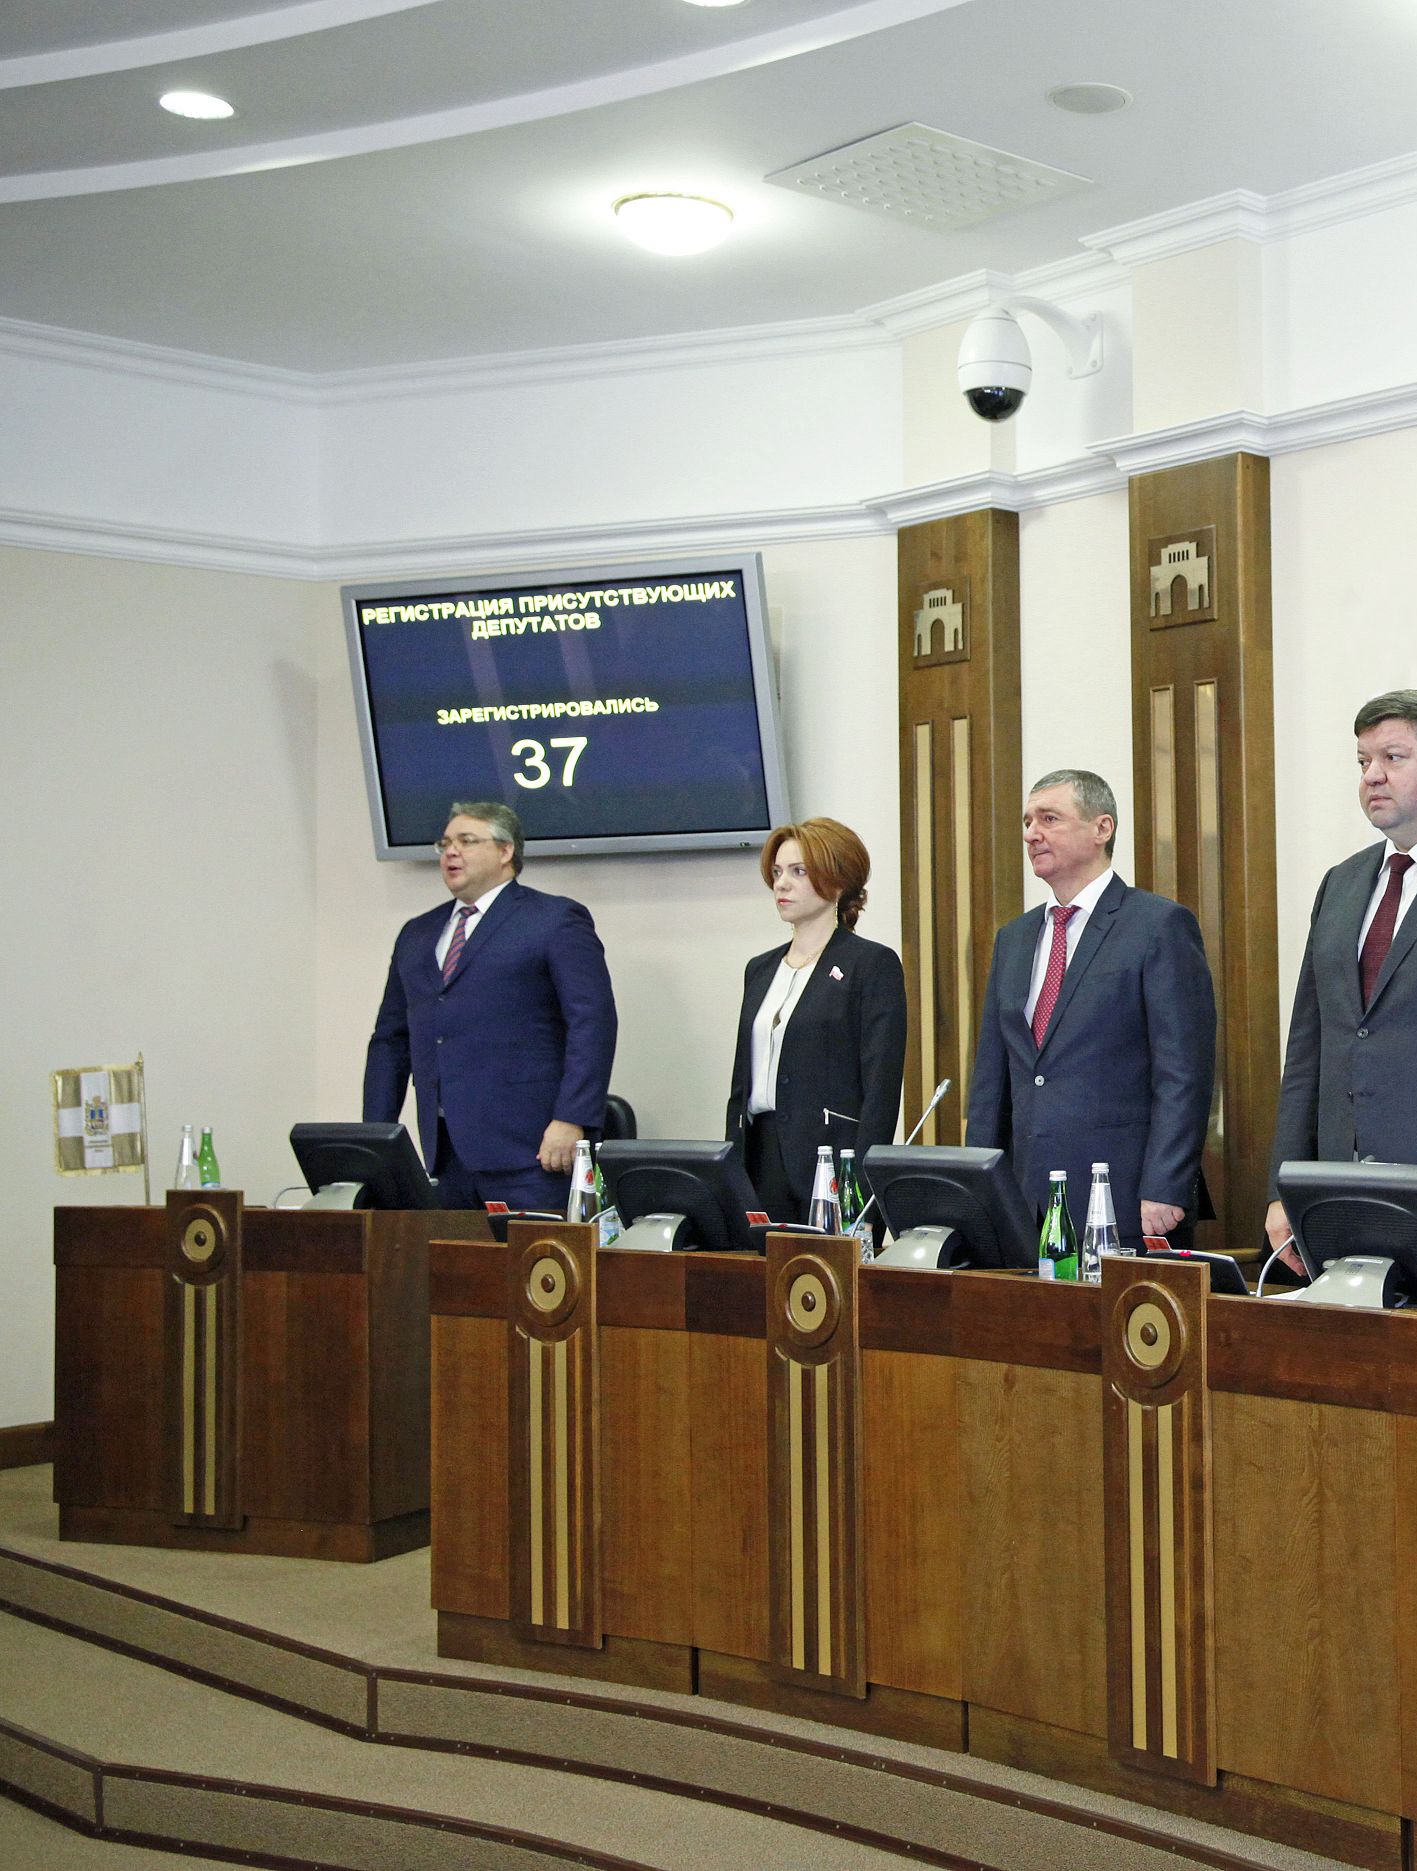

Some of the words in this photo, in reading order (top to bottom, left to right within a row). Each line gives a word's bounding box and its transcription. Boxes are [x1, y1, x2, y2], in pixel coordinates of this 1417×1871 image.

[361, 597, 514, 625] РЕГИСТРАЦИЯ
[518, 580, 736, 613] ПРИСУТСТВУЮЩИХ
[471, 611, 601, 640] ДЕПУТАТОВ
[436, 697, 660, 725] ЗАРЕГИСТРИРОВАЛИСЬ
[511, 736, 588, 789] 37
